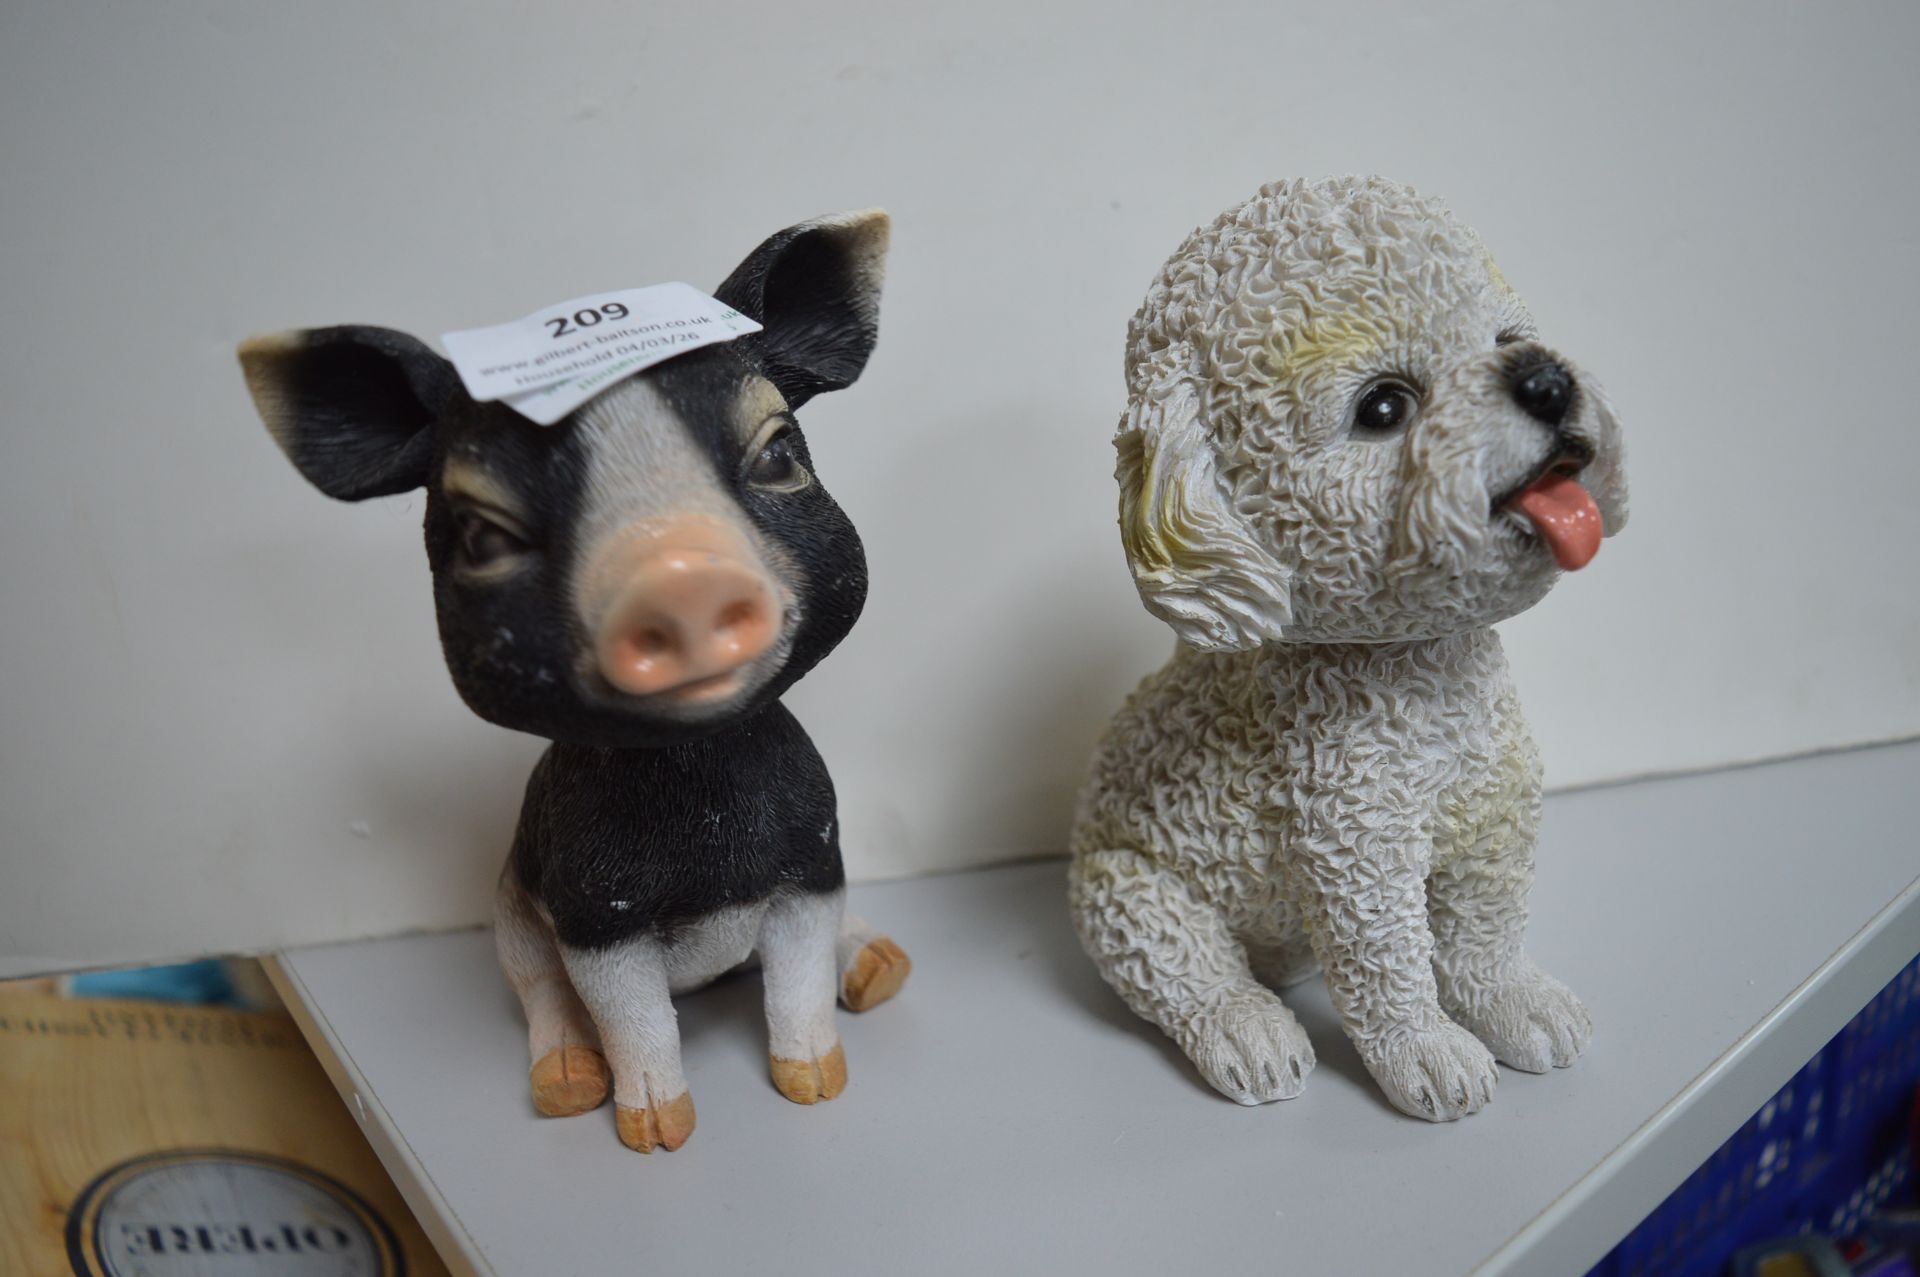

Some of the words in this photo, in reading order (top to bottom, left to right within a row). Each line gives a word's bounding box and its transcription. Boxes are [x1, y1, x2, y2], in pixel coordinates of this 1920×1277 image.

[480, 315, 712, 377] www.gilbert-baitson.co.uk
[545, 302, 629, 338] 209
[515, 348, 613, 386] Household
[616, 331, 700, 356] 04/03/26
